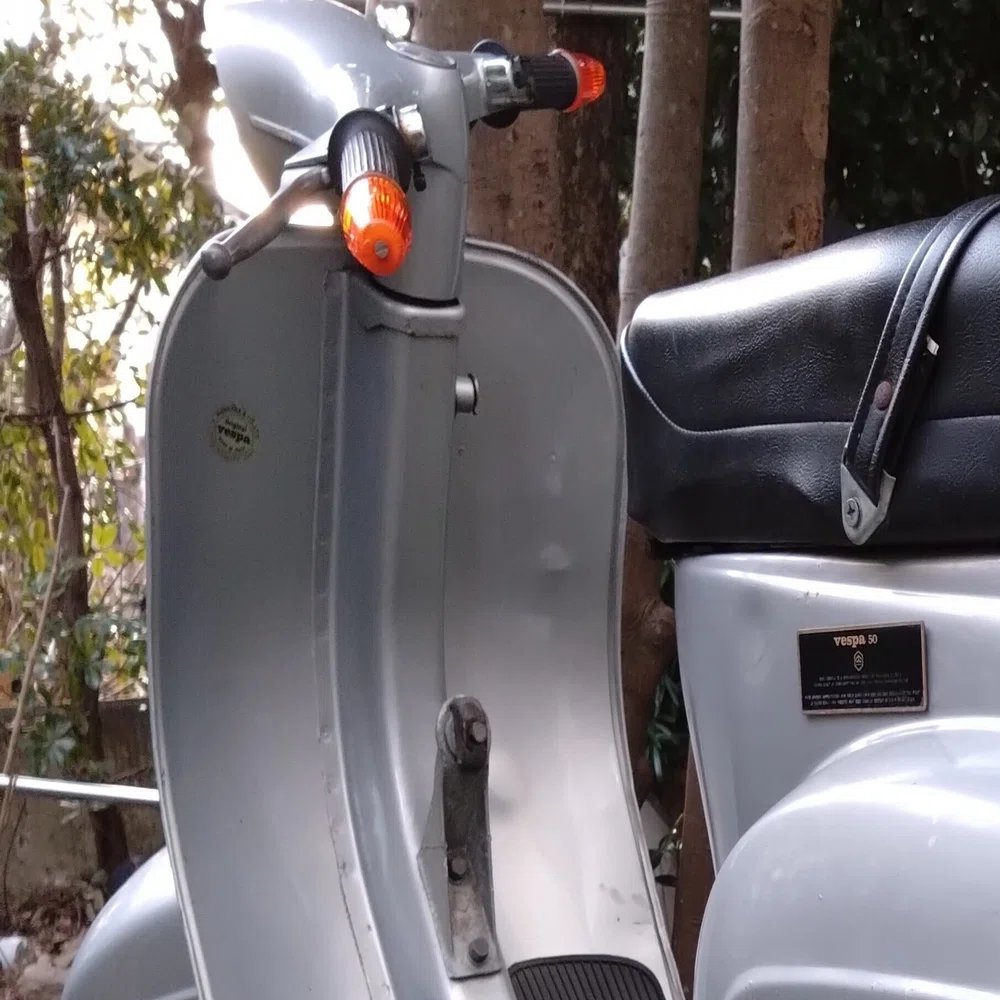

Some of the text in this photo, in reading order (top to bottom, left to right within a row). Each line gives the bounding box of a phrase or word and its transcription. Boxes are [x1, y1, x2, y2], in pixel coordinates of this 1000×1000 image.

[218, 425, 250, 445] vespa
[833, 634, 878, 648] vespa 50
